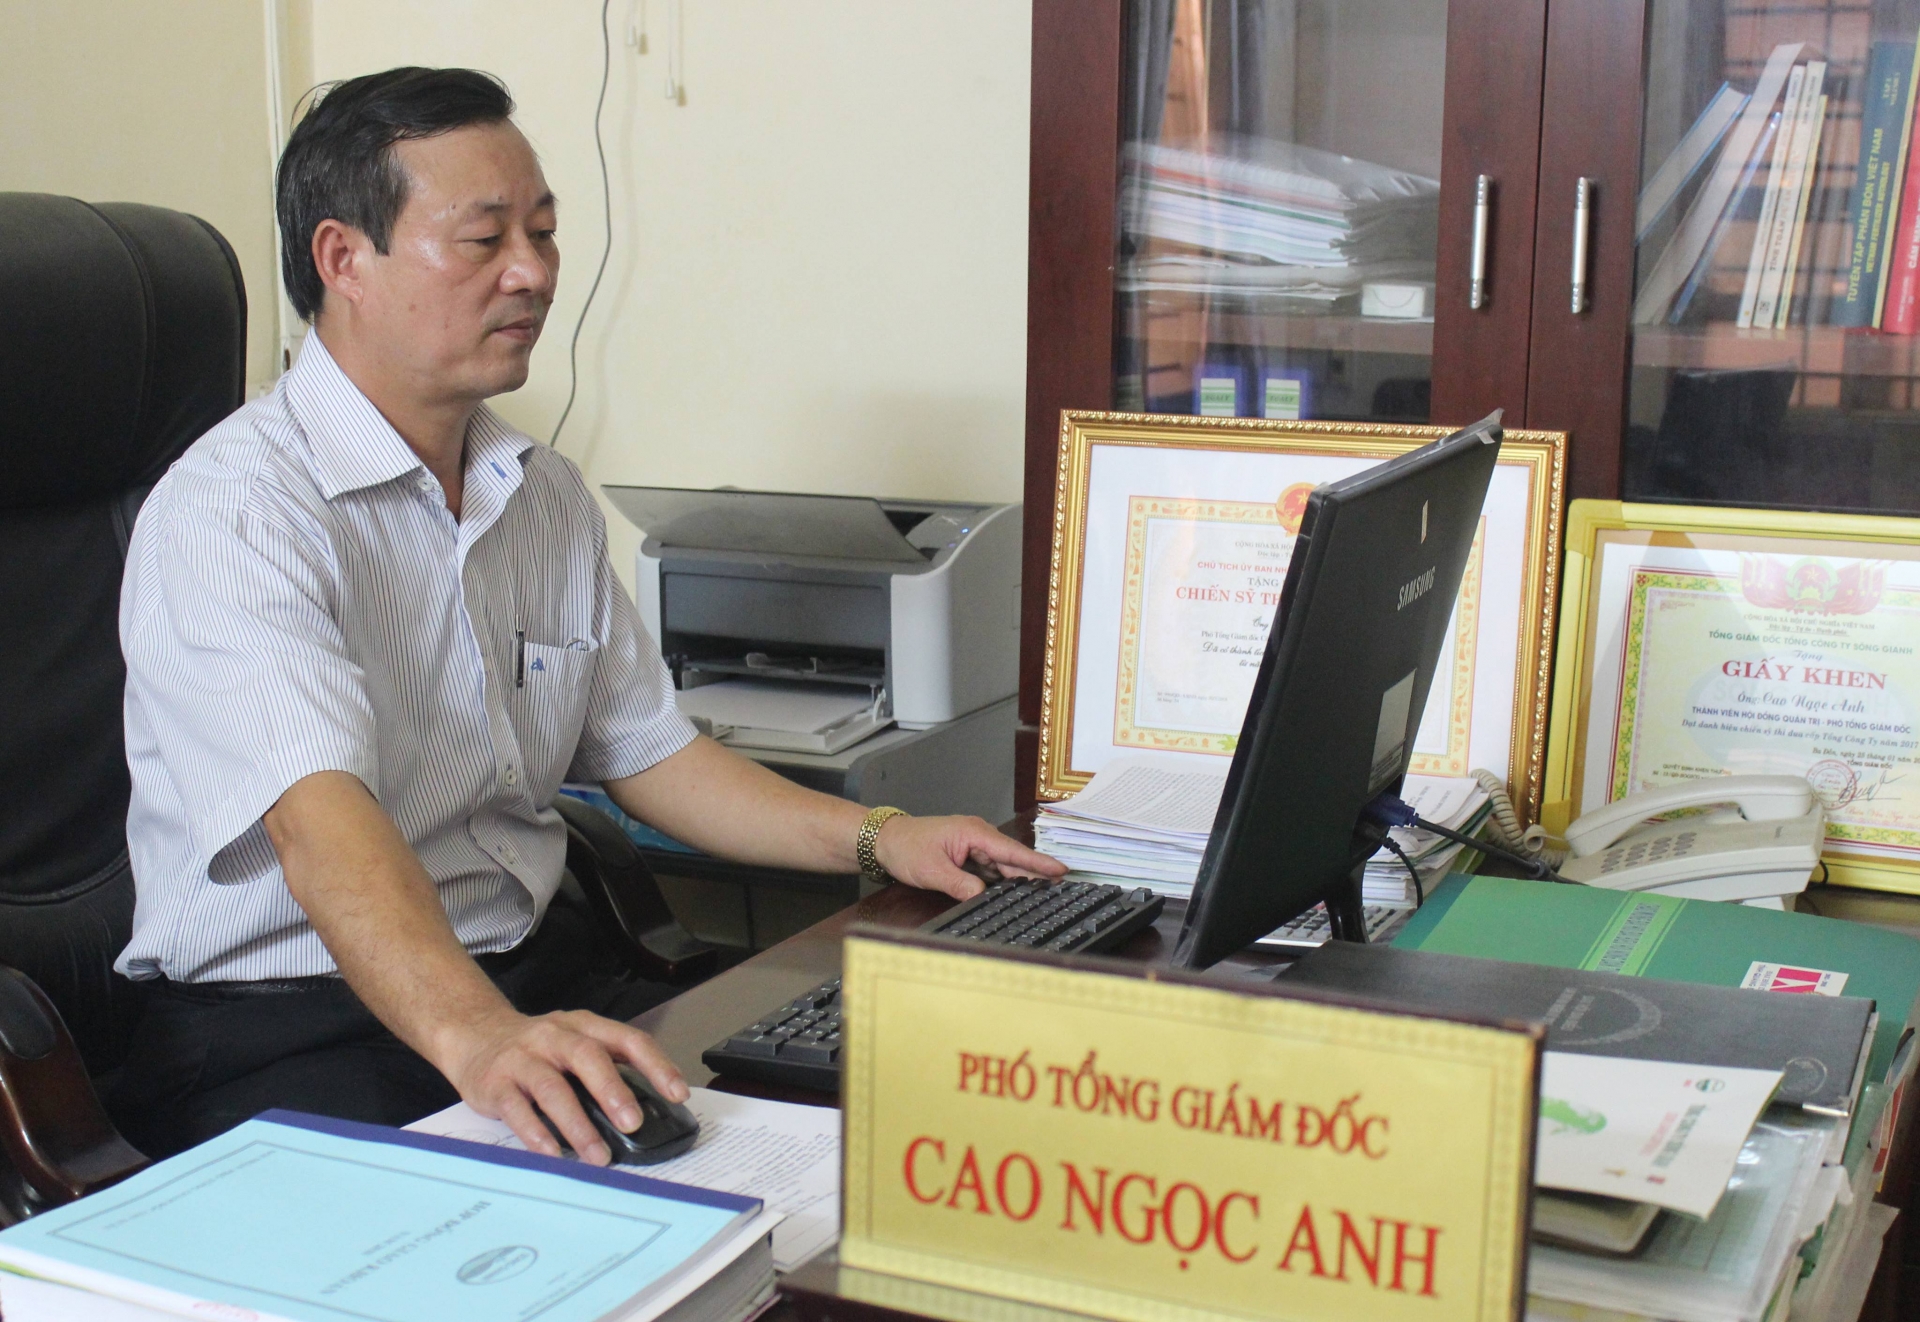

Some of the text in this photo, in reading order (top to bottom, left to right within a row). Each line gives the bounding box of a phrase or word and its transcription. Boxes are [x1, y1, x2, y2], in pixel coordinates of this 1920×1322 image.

[1871, 128, 1883, 154] NAM
[1197, 560, 1216, 569] CHỦ
[1254, 565, 1272, 573] BAN
[1274, 566, 1288, 574] NH
[1176, 584, 1281, 606] CHIẾN SỸ TH
[1397, 566, 1435, 611] SAMSUNG
[1840, 641, 1851, 650] TY
[1882, 645, 1913, 655] GIANH
[1722, 656, 1888, 690] GIẤY KHEN
[1762, 691, 1787, 707] Cao
[1790, 694, 1828, 713] Ngọc
[1900, 740, 1919, 749] 2017
[957, 1051, 1390, 1159] PHÓ TỔNG GIÁM ĐỐC
[904, 1135, 1043, 1222] CAO
[1060, 1162, 1261, 1271] NGỌC
[1278, 1203, 1443, 1298] ANH
